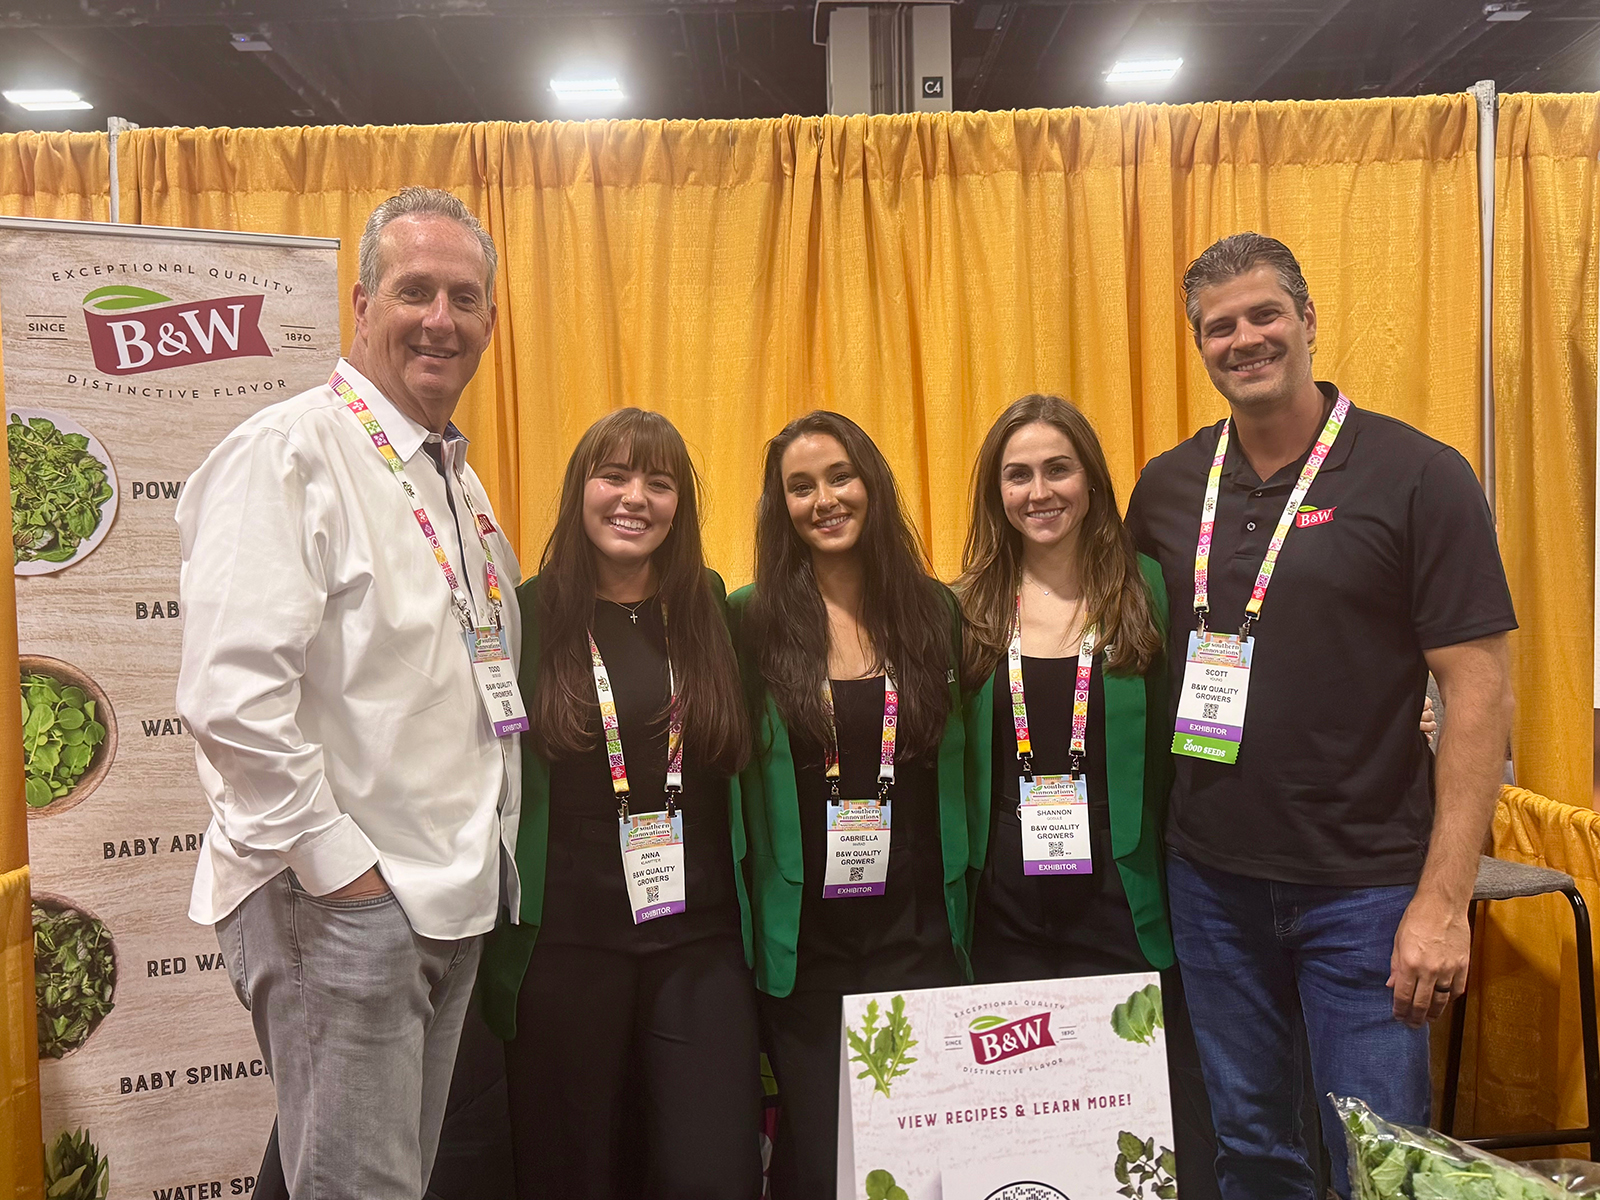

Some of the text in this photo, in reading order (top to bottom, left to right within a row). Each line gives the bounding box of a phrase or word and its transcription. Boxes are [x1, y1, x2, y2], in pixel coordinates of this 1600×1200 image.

[924, 81, 941, 94] C4
[52, 263, 294, 294] EXCEPTIONAL QUALITY
[28, 322, 66, 333] SINCE
[106, 304, 245, 370] B&W
[285, 332, 312, 342] 1870
[67, 374, 287, 399] DISTINCTIVE FLAVOR
[132, 481, 187, 500] POW
[1300, 509, 1333, 527] B&W
[135, 601, 180, 620] BAB
[1205, 668, 1228, 678] SCOTT
[496, 681, 513, 689] QUALITY
[1191, 683, 1239, 695] B&W QUALITY
[492, 690, 513, 699] GROWERS
[1195, 692, 1231, 703] GROWERS
[141, 718, 183, 737] WAT
[502, 722, 523, 733] EXHIBITOR
[1189, 723, 1228, 736] EXHIBITOR
[1183, 742, 1226, 757] GOOD SEEDS
[103, 837, 160, 859] BABY
[853, 849, 882, 857] QUALITY
[640, 851, 660, 860] ANNA
[632, 865, 676, 879] B&W QUALITY
[1038, 863, 1077, 871] EXHIBITOR
[637, 874, 670, 887] GROWERS
[641, 906, 671, 920] EXHIBITOR
[147, 953, 227, 977] RED WA
[954, 1000, 1065, 1018] EXCEPTIONAL QUALITY
[945, 1039, 962, 1047] SINCE
[979, 1018, 1043, 1062] B&W
[963, 1057, 1063, 1076] DISTINCTIVE FLAVOR
[120, 1059, 269, 1094] BABY SPINAC
[897, 1093, 1132, 1130] VIEW RECIPES & LEARN MORE!
[153, 1176, 259, 1200] WATER SP
